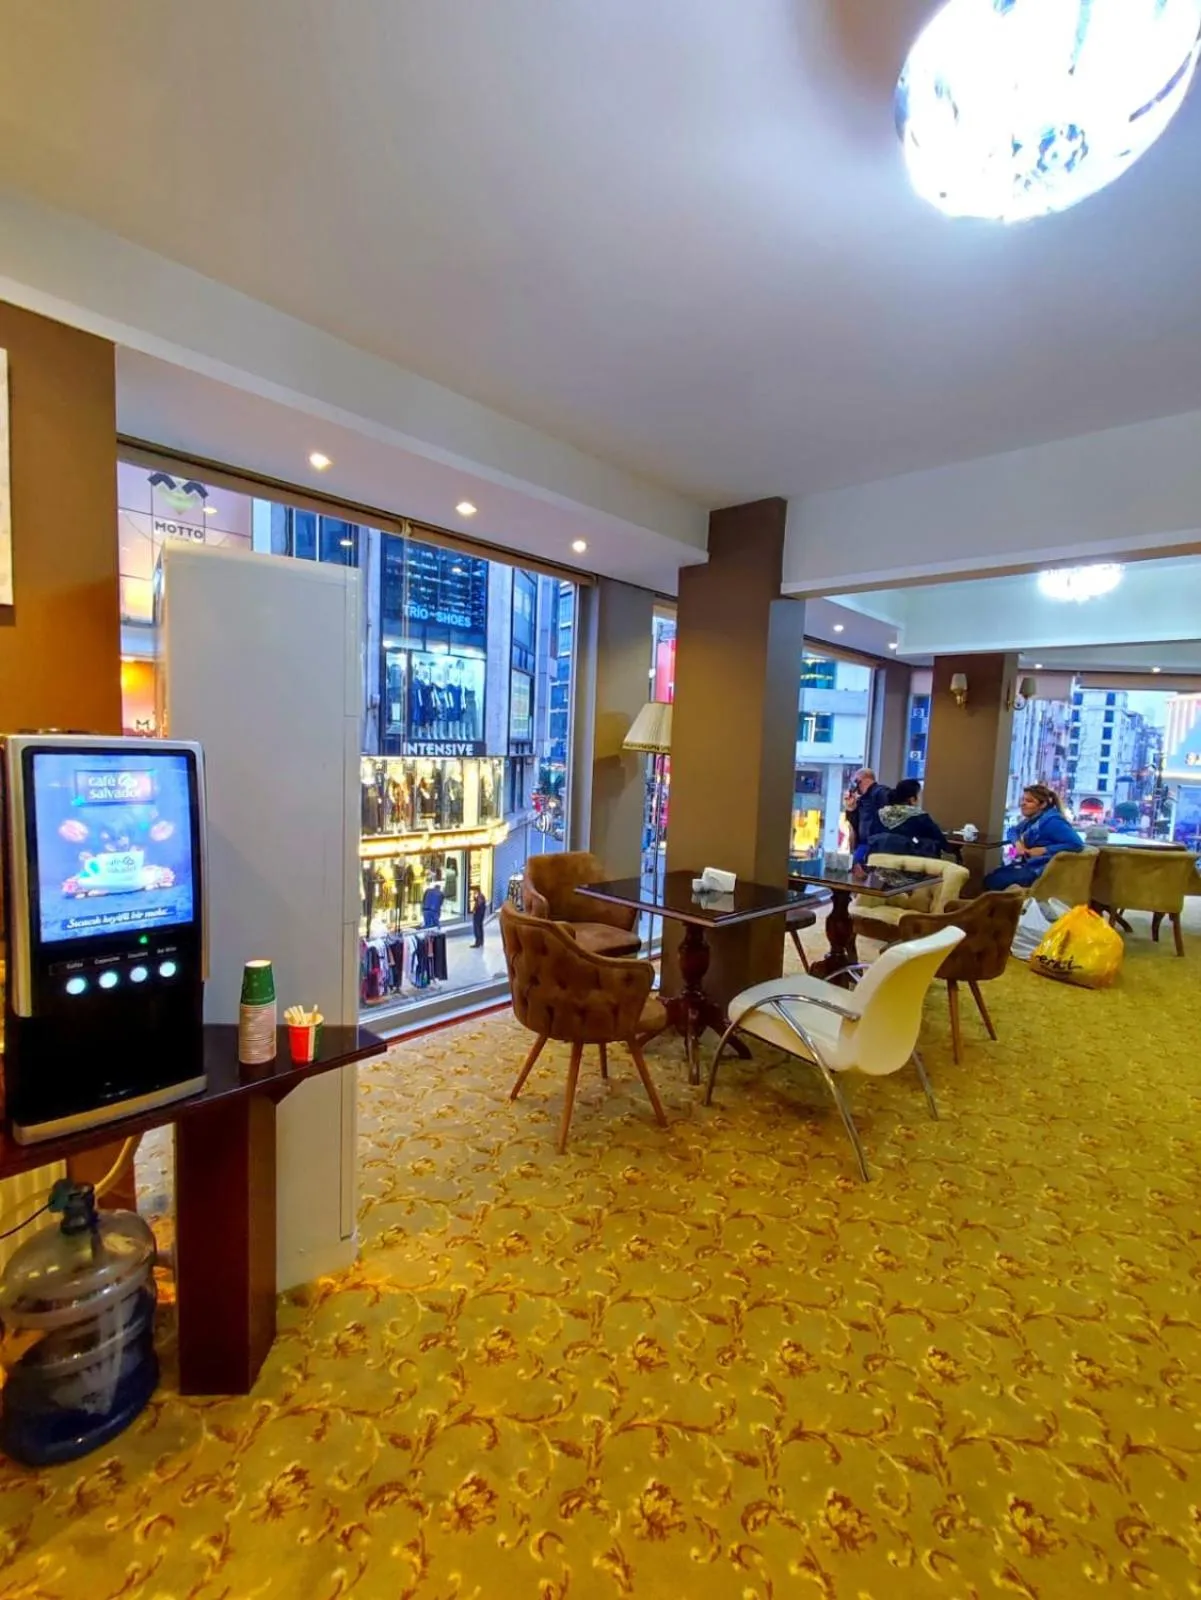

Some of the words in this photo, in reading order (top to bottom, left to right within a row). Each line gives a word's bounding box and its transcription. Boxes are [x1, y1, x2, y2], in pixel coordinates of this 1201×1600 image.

[155, 521, 204, 543] MOTTO
[436, 611, 473, 627] SHOES
[402, 742, 474, 756] INTENSIVE
